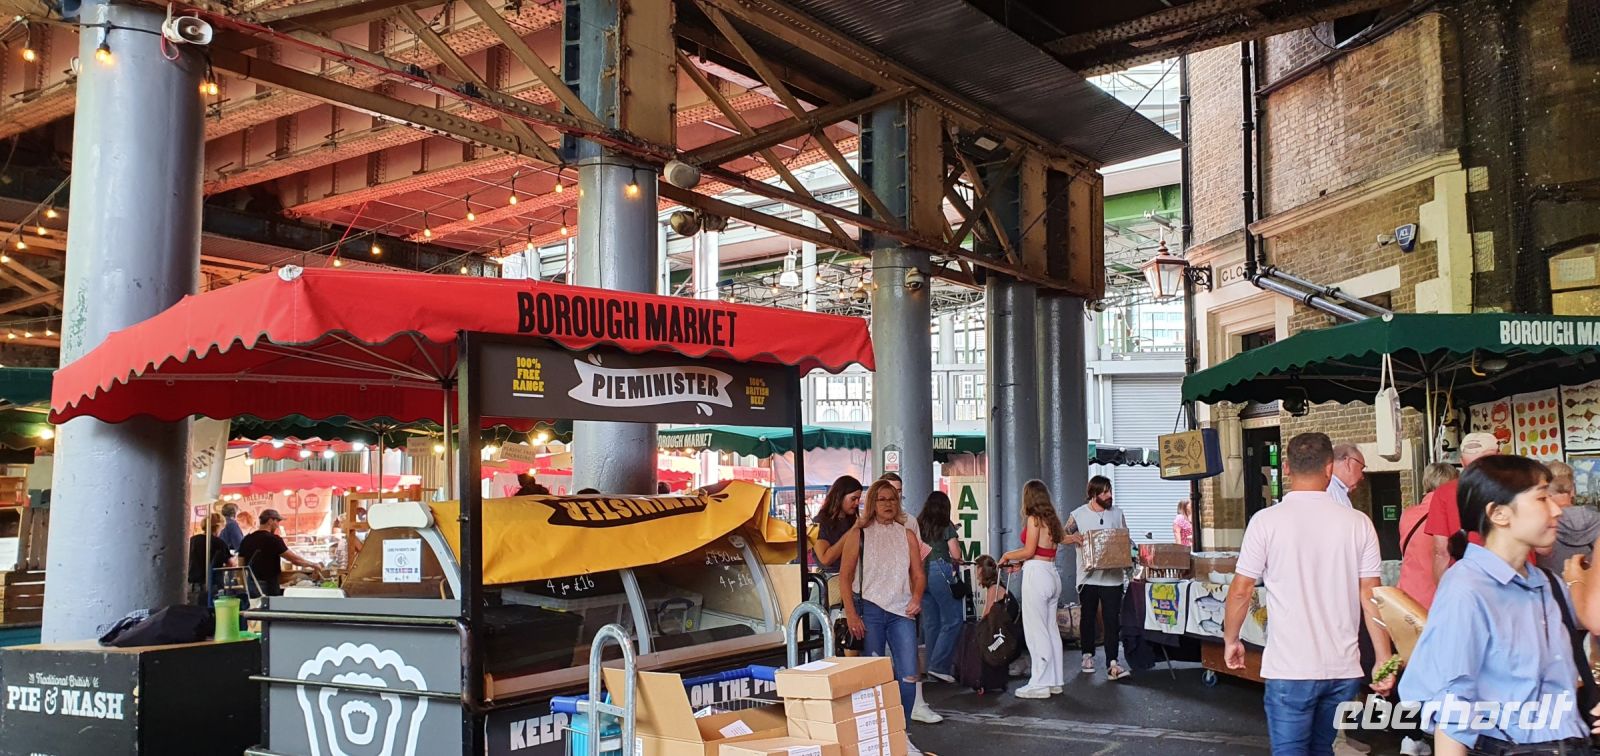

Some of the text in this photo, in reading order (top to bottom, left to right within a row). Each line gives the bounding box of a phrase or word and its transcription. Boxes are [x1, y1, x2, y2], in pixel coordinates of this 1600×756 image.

[517, 291, 738, 348] BOROUGH MARKET
[1499, 320, 1600, 345] BOROUGH MA
[516, 356, 542, 369] 100%
[517, 368, 541, 380] FREE
[513, 379, 545, 392] RANGE
[591, 372, 719, 400] PIEMINISTER
[657, 433, 713, 448] OROUGH MARKET
[957, 485, 981, 566] ATM
[546, 579, 556, 594] 4
[574, 575, 595, 592] £16
[720, 576, 727, 588] 4
[6, 685, 124, 720] PIE & MASH
[510, 712, 569, 751] KEEP
[691, 682, 714, 709] ON
[719, 677, 750, 701] THE
